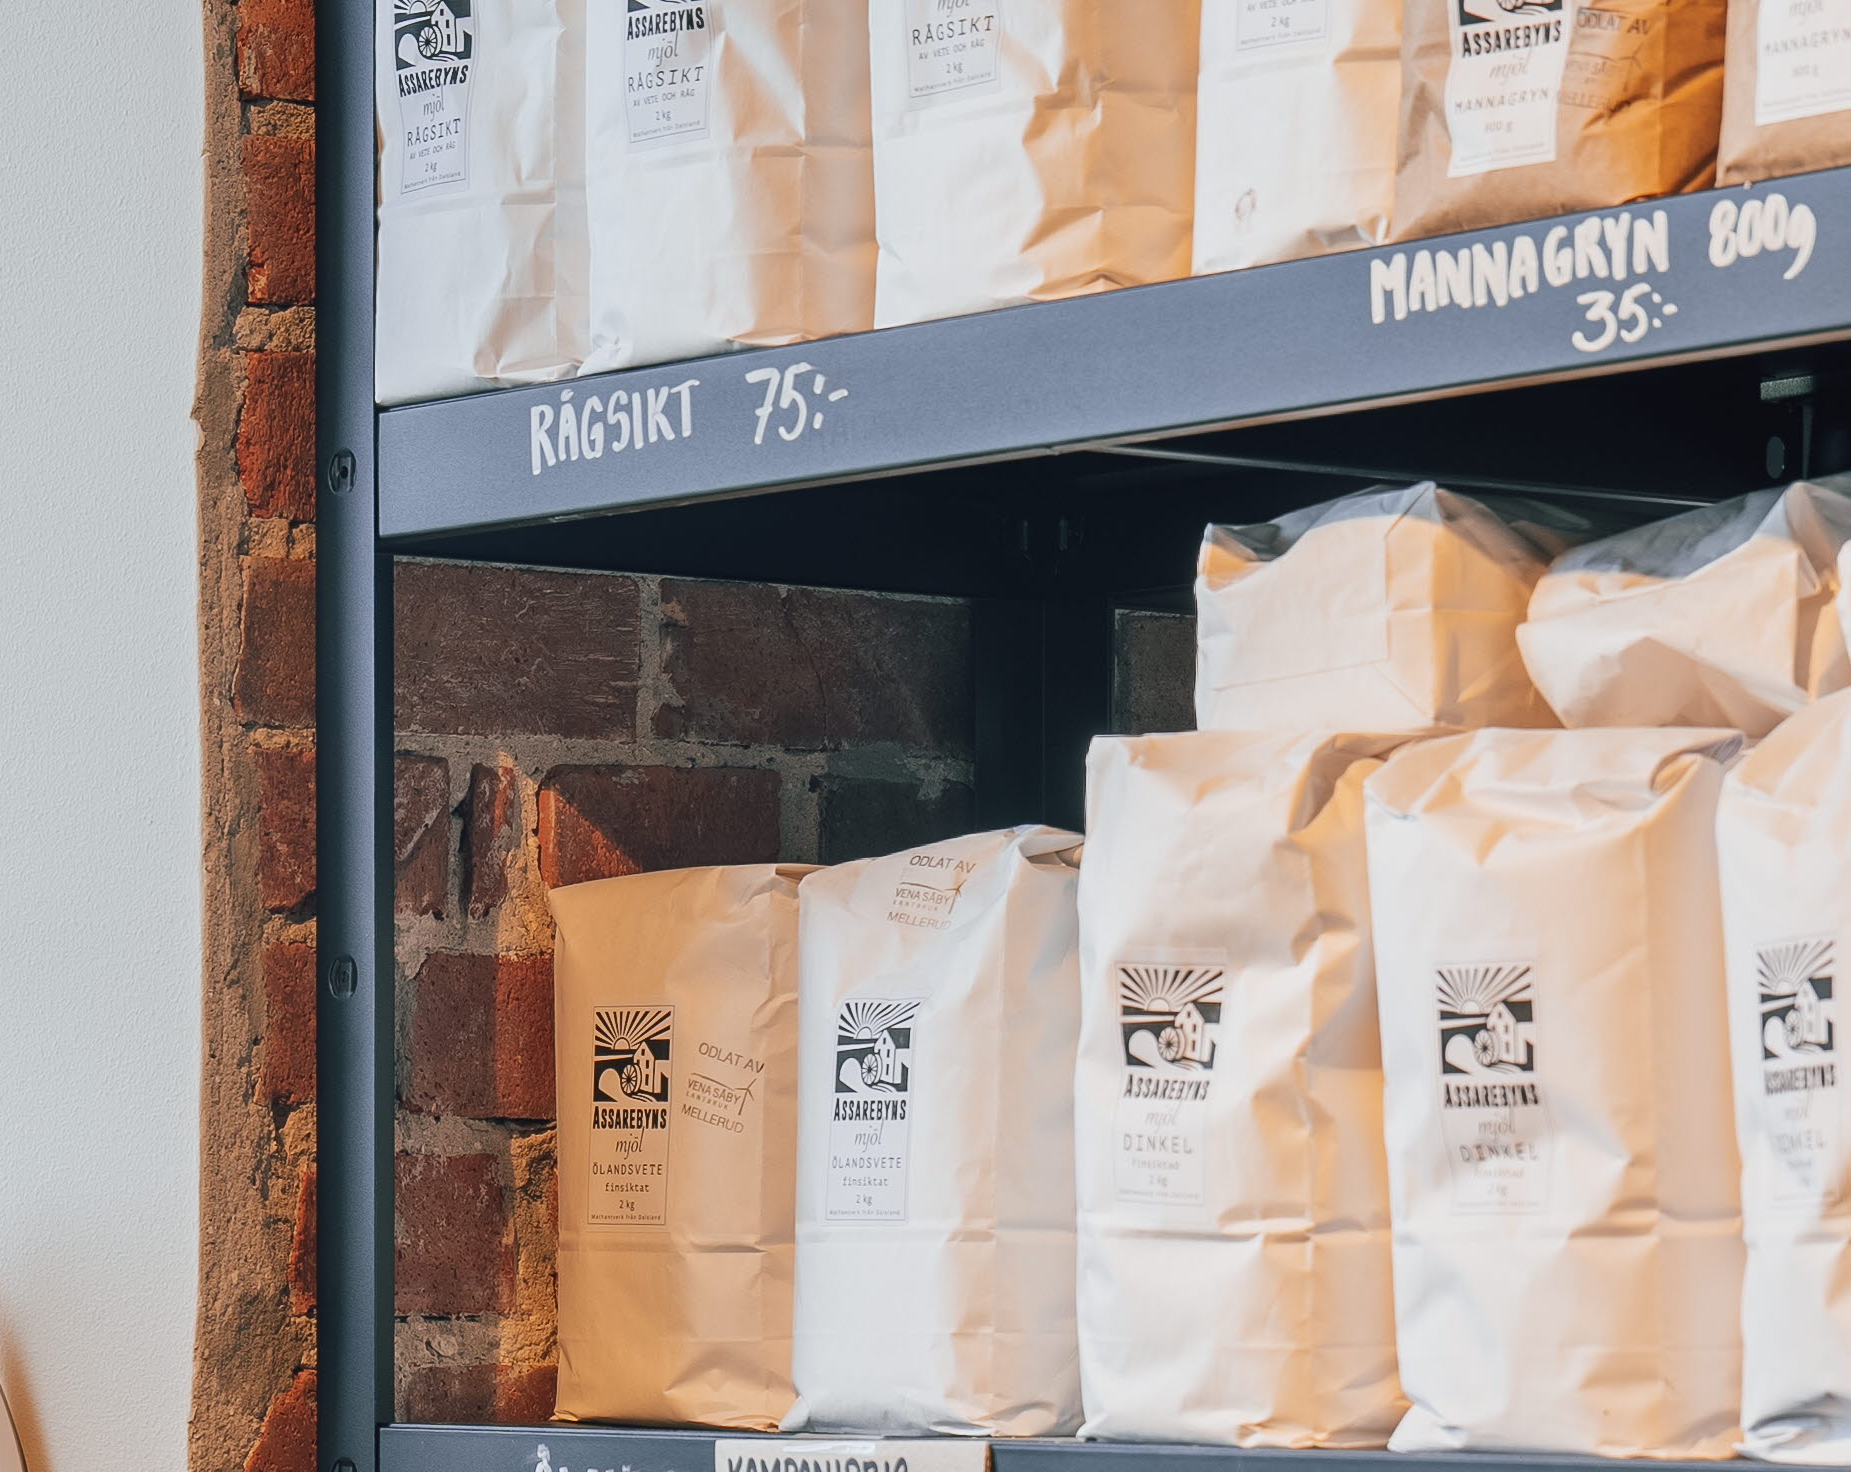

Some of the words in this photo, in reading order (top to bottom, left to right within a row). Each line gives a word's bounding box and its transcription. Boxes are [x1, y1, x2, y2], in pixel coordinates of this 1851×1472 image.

[626, 7, 705, 41] ASSAREBYNS
[912, 15, 994, 46] RÅGSIKT
[1462, 20, 1562, 57] ASSAREBYNS
[399, 65, 469, 97] ASSAREBYNS
[628, 66, 704, 93] RÅGSIKT
[407, 118, 461, 147] RÅGSIKT
[1370, 210, 1669, 324] MANNAGRYN
[1708, 194, 1817, 280] 800g
[529, 378, 701, 477] RÅGSIKT
[909, 855, 954, 869] ODLAT
[953, 860, 976, 874] AV
[698, 1042, 743, 1066] ODLAT
[743, 1059, 765, 1073] AV
[687, 1079, 711, 1093] VENA
[1123, 1073, 1210, 1101] ASSAREBYNS
[1445, 1083, 1539, 1107] ASSAREBYNS
[593, 1106, 667, 1129] ASSAREBYNS
[681, 1103, 744, 1133] MELLERUD
[833, 1098, 907, 1121] ASSAREBYNS
[1123, 1134, 1192, 1154] DINKEL
[1459, 1142, 1538, 1162] DINKEL
[593, 1162, 663, 1175] ÖLANDSVETE
[605, 1183, 650, 1192] finsiktat
